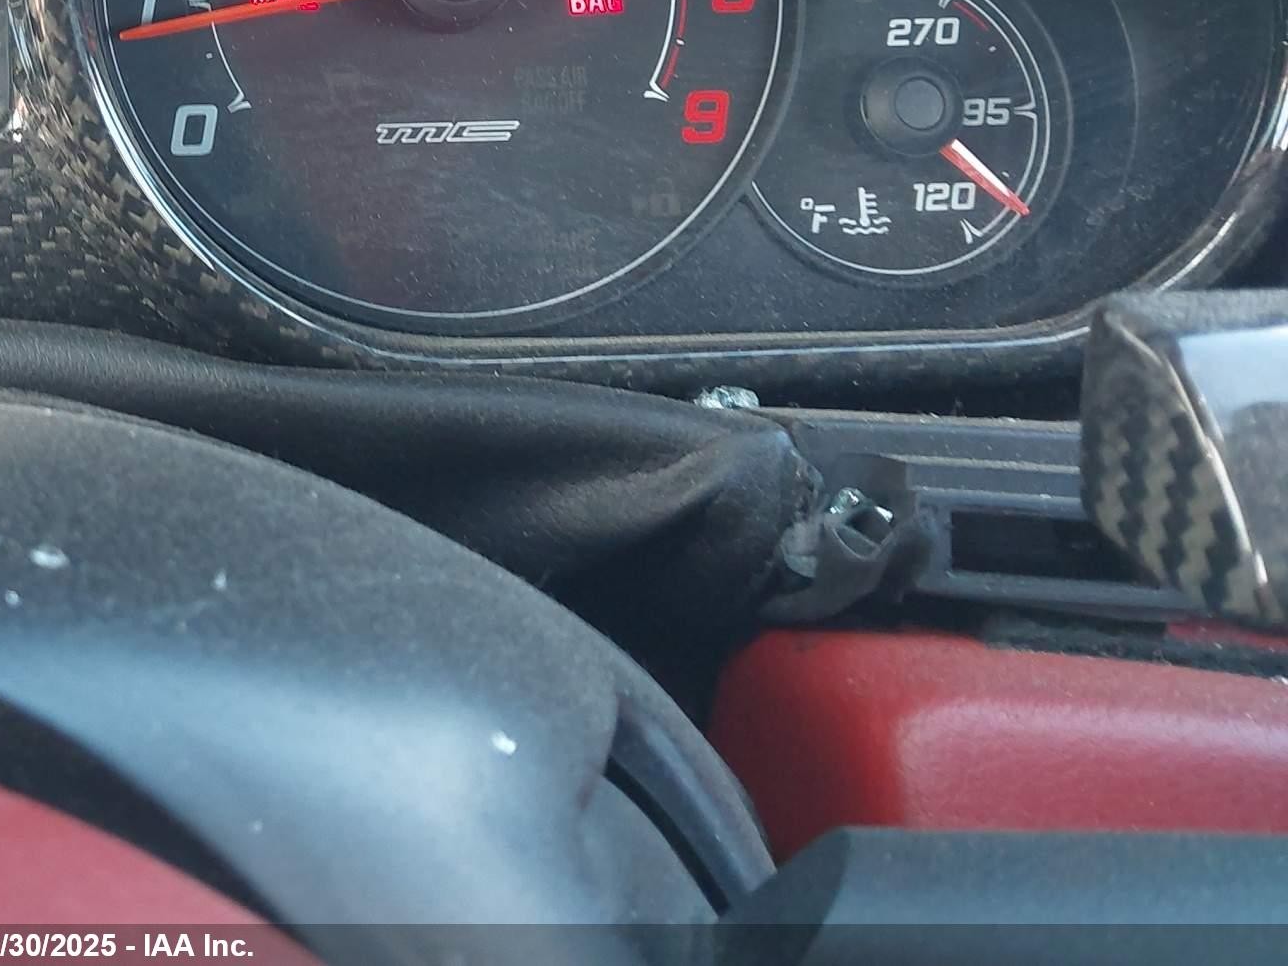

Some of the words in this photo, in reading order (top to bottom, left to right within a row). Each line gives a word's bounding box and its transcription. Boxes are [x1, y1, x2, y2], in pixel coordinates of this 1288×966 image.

[886, 17, 960, 47] 270
[681, 91, 730, 143] 9
[962, 97, 1011, 127] 95
[171, 105, 217, 156] 0
[912, 182, 976, 212] 120
